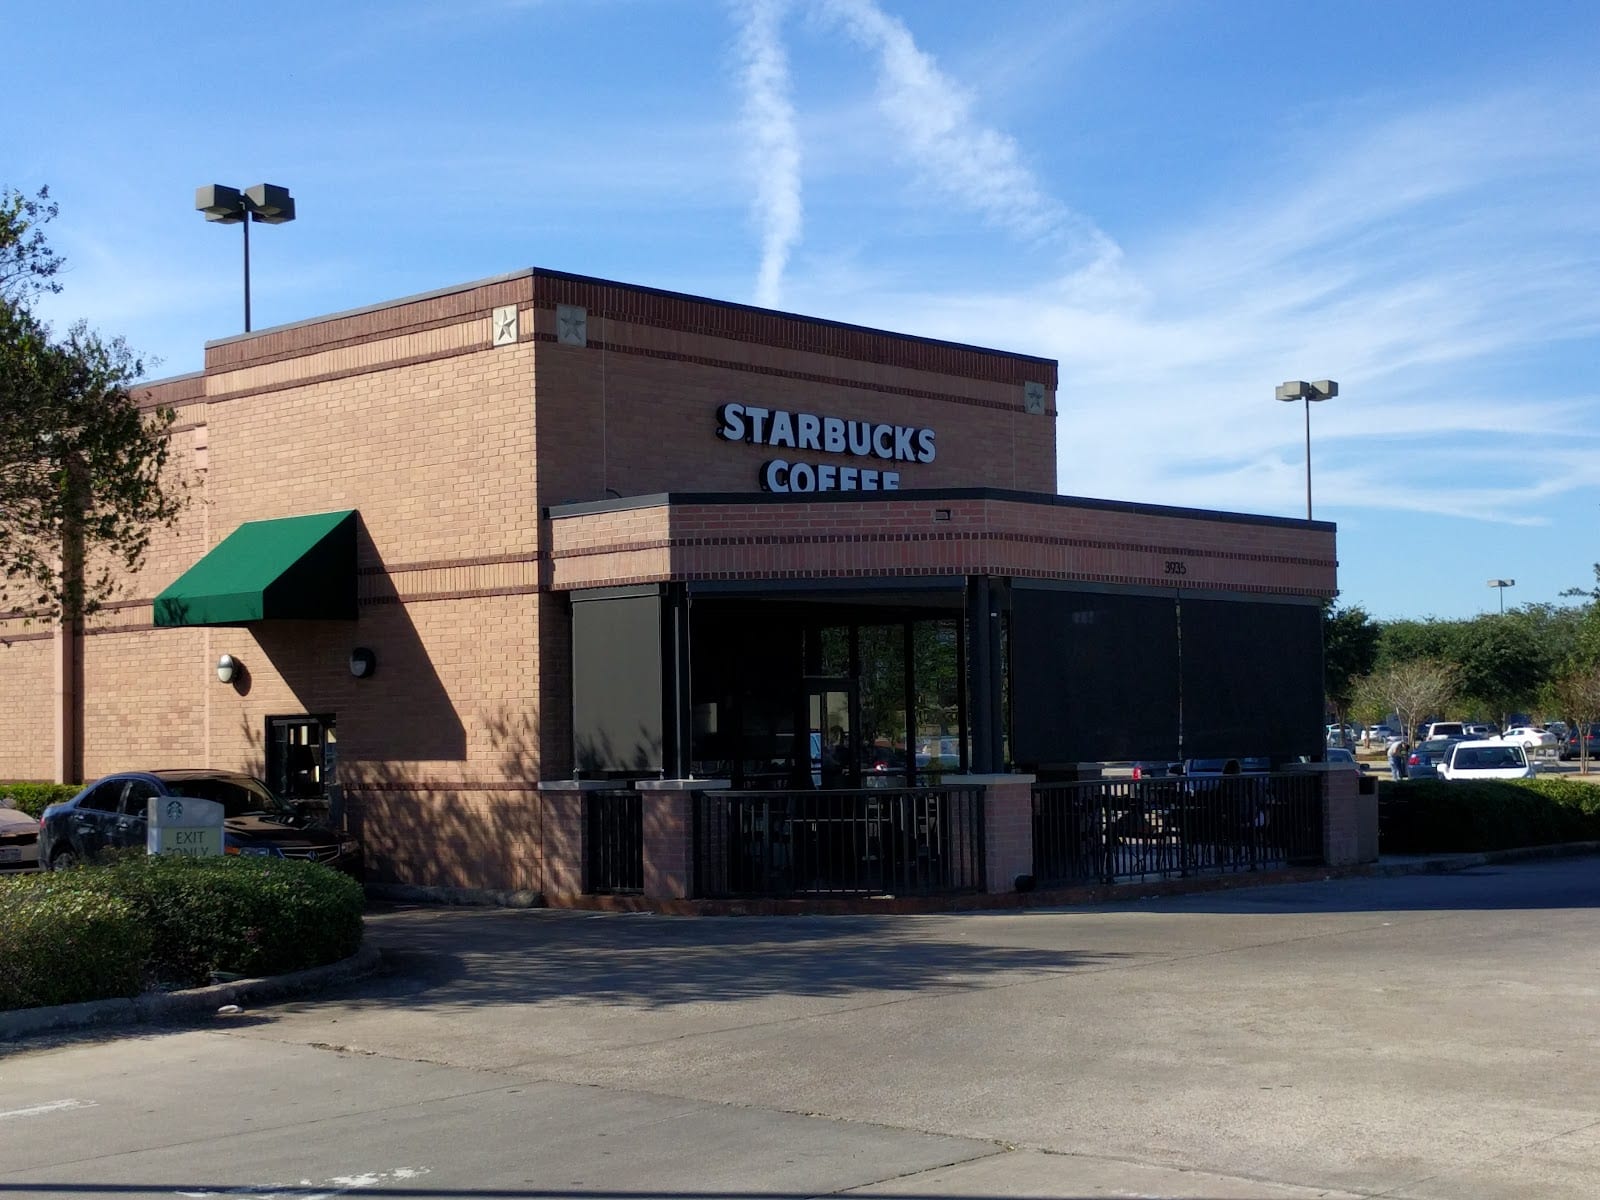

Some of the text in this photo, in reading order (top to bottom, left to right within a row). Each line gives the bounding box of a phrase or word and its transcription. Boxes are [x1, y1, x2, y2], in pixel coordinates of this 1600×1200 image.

[718, 402, 936, 463] STARBUCKS
[1165, 561, 1187, 575] 3935
[176, 831, 206, 844] EXIT
